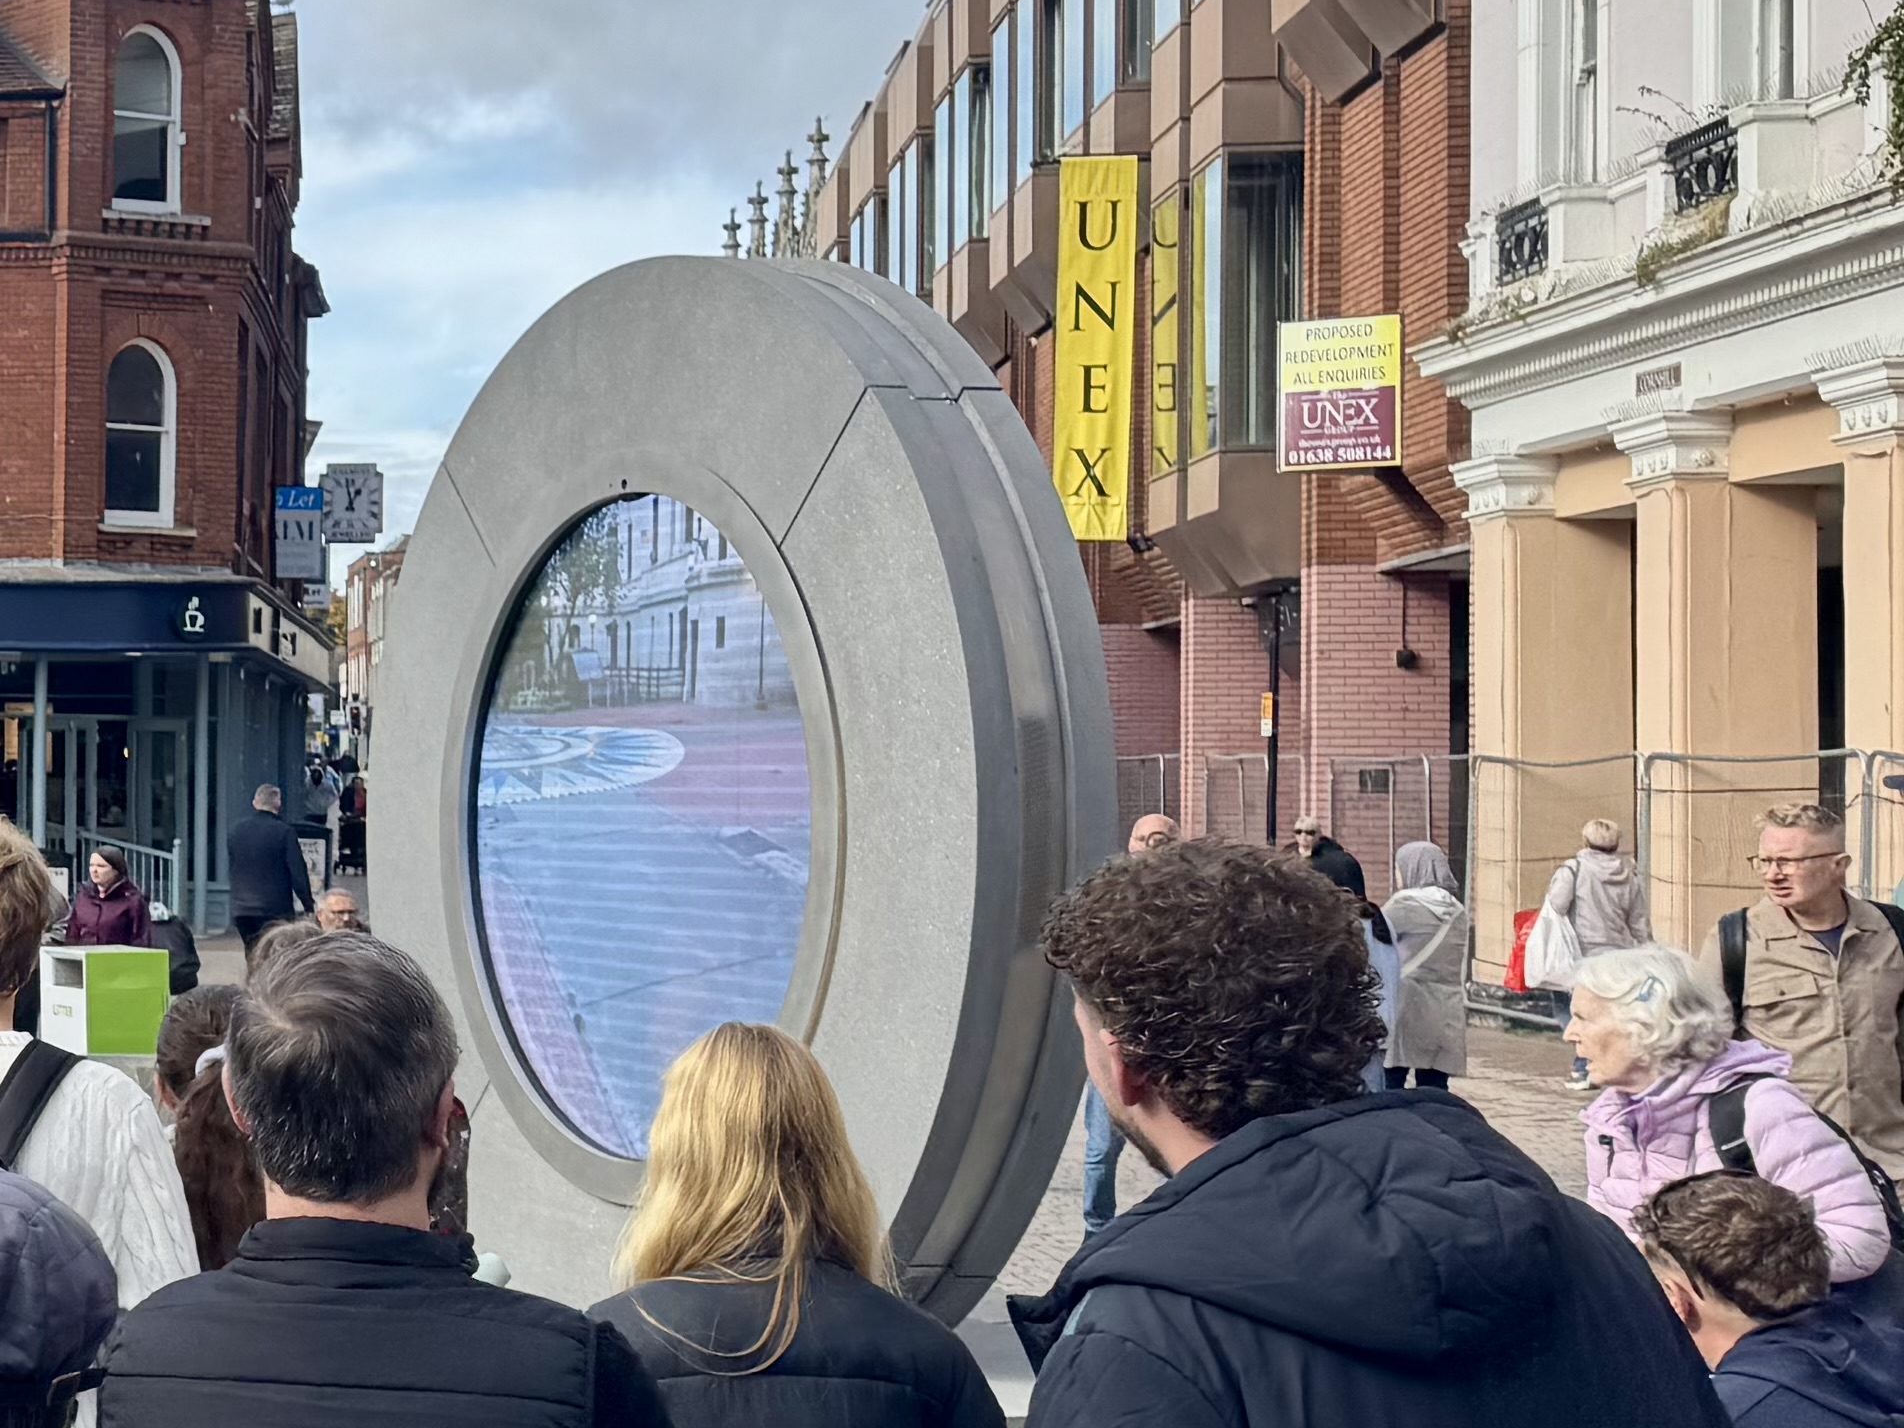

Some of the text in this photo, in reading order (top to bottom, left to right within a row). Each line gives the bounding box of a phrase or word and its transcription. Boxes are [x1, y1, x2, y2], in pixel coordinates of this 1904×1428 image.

[1306, 324, 1373, 342] PROPOSED
[1069, 199, 1122, 498] UNEX
[1285, 343, 1394, 364] REDEVELOPMENT
[1293, 366, 1386, 385] ALL ENQUIRIES
[1302, 398, 1379, 429] UNEX
[1288, 445, 1392, 465] 01638 508144
[287, 489, 314, 507] Let
